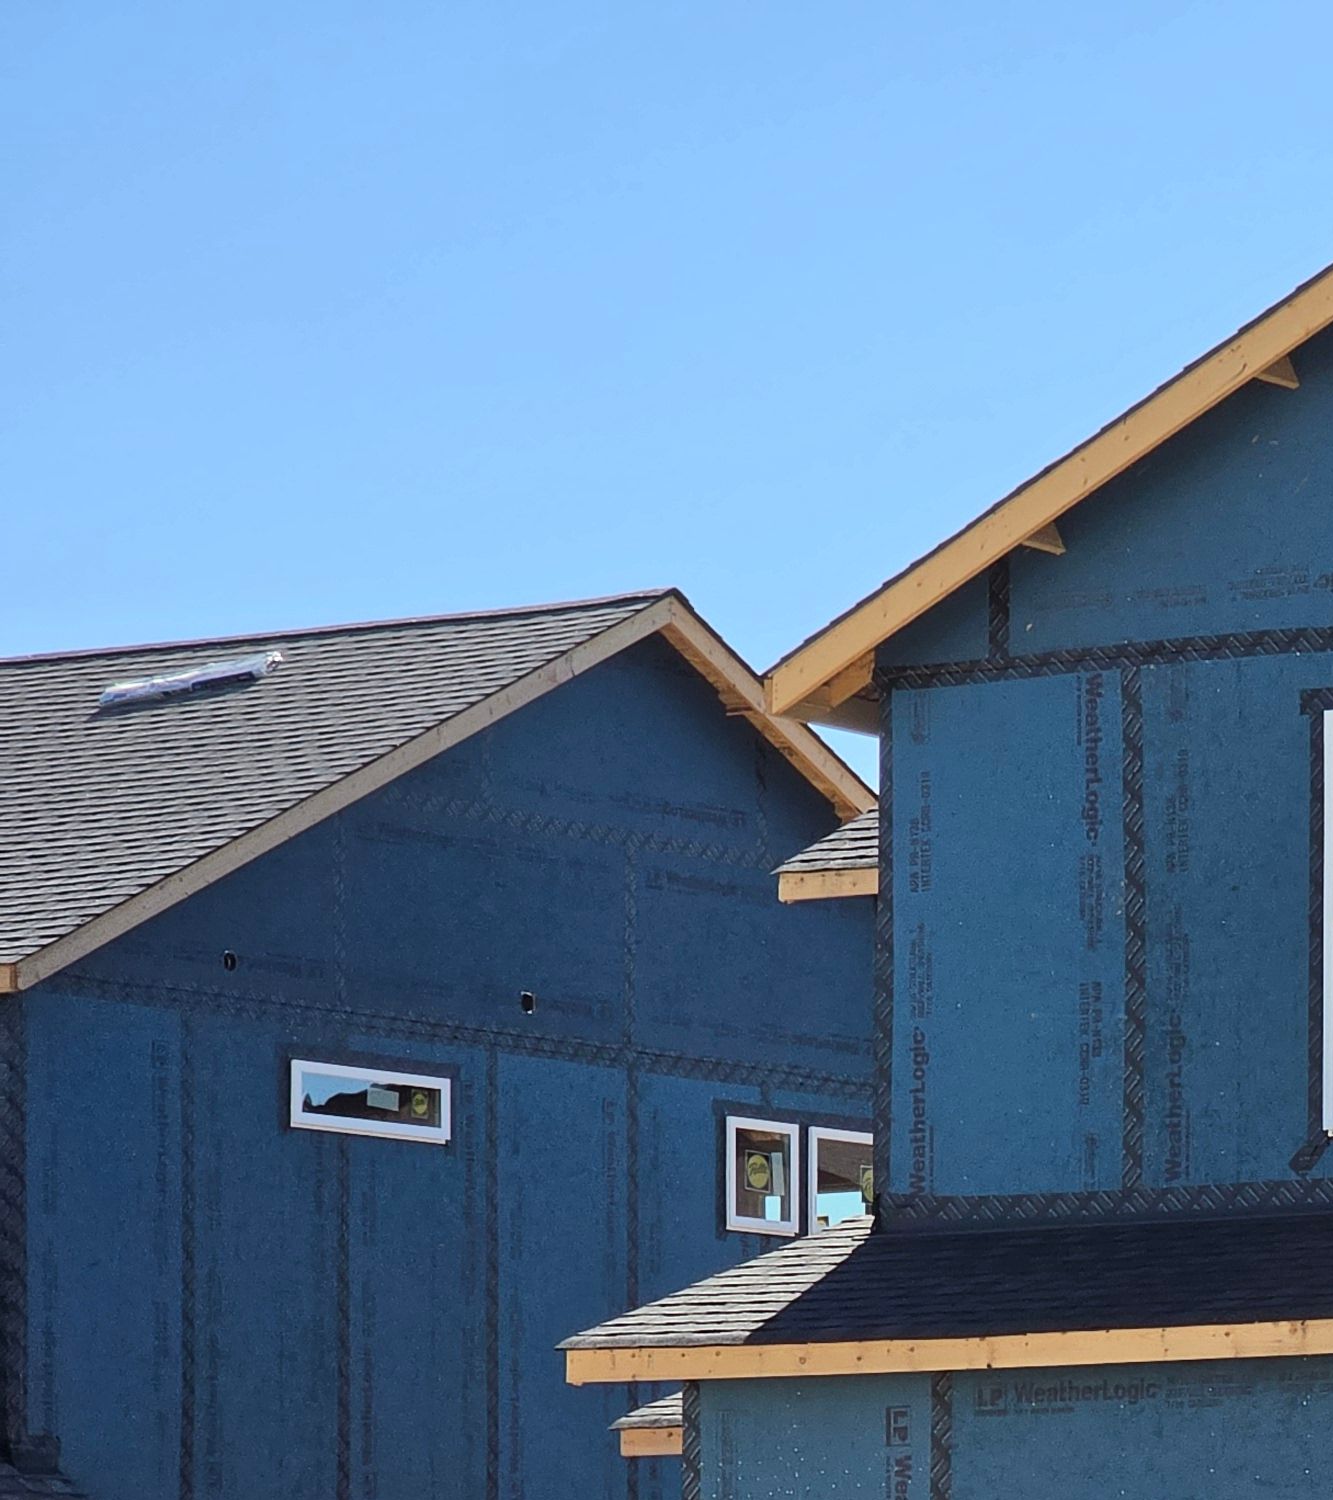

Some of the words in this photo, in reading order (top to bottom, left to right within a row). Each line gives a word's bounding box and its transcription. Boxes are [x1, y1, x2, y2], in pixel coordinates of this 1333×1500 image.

[1081, 673, 1104, 843] WeatherLogic
[909, 1029, 930, 1196] WeatherLogic
[1164, 1012, 1186, 1184] WeatherLogic
[893, 1410, 909, 1442] LP
[1015, 1375, 1162, 1405] WeatherLogic
